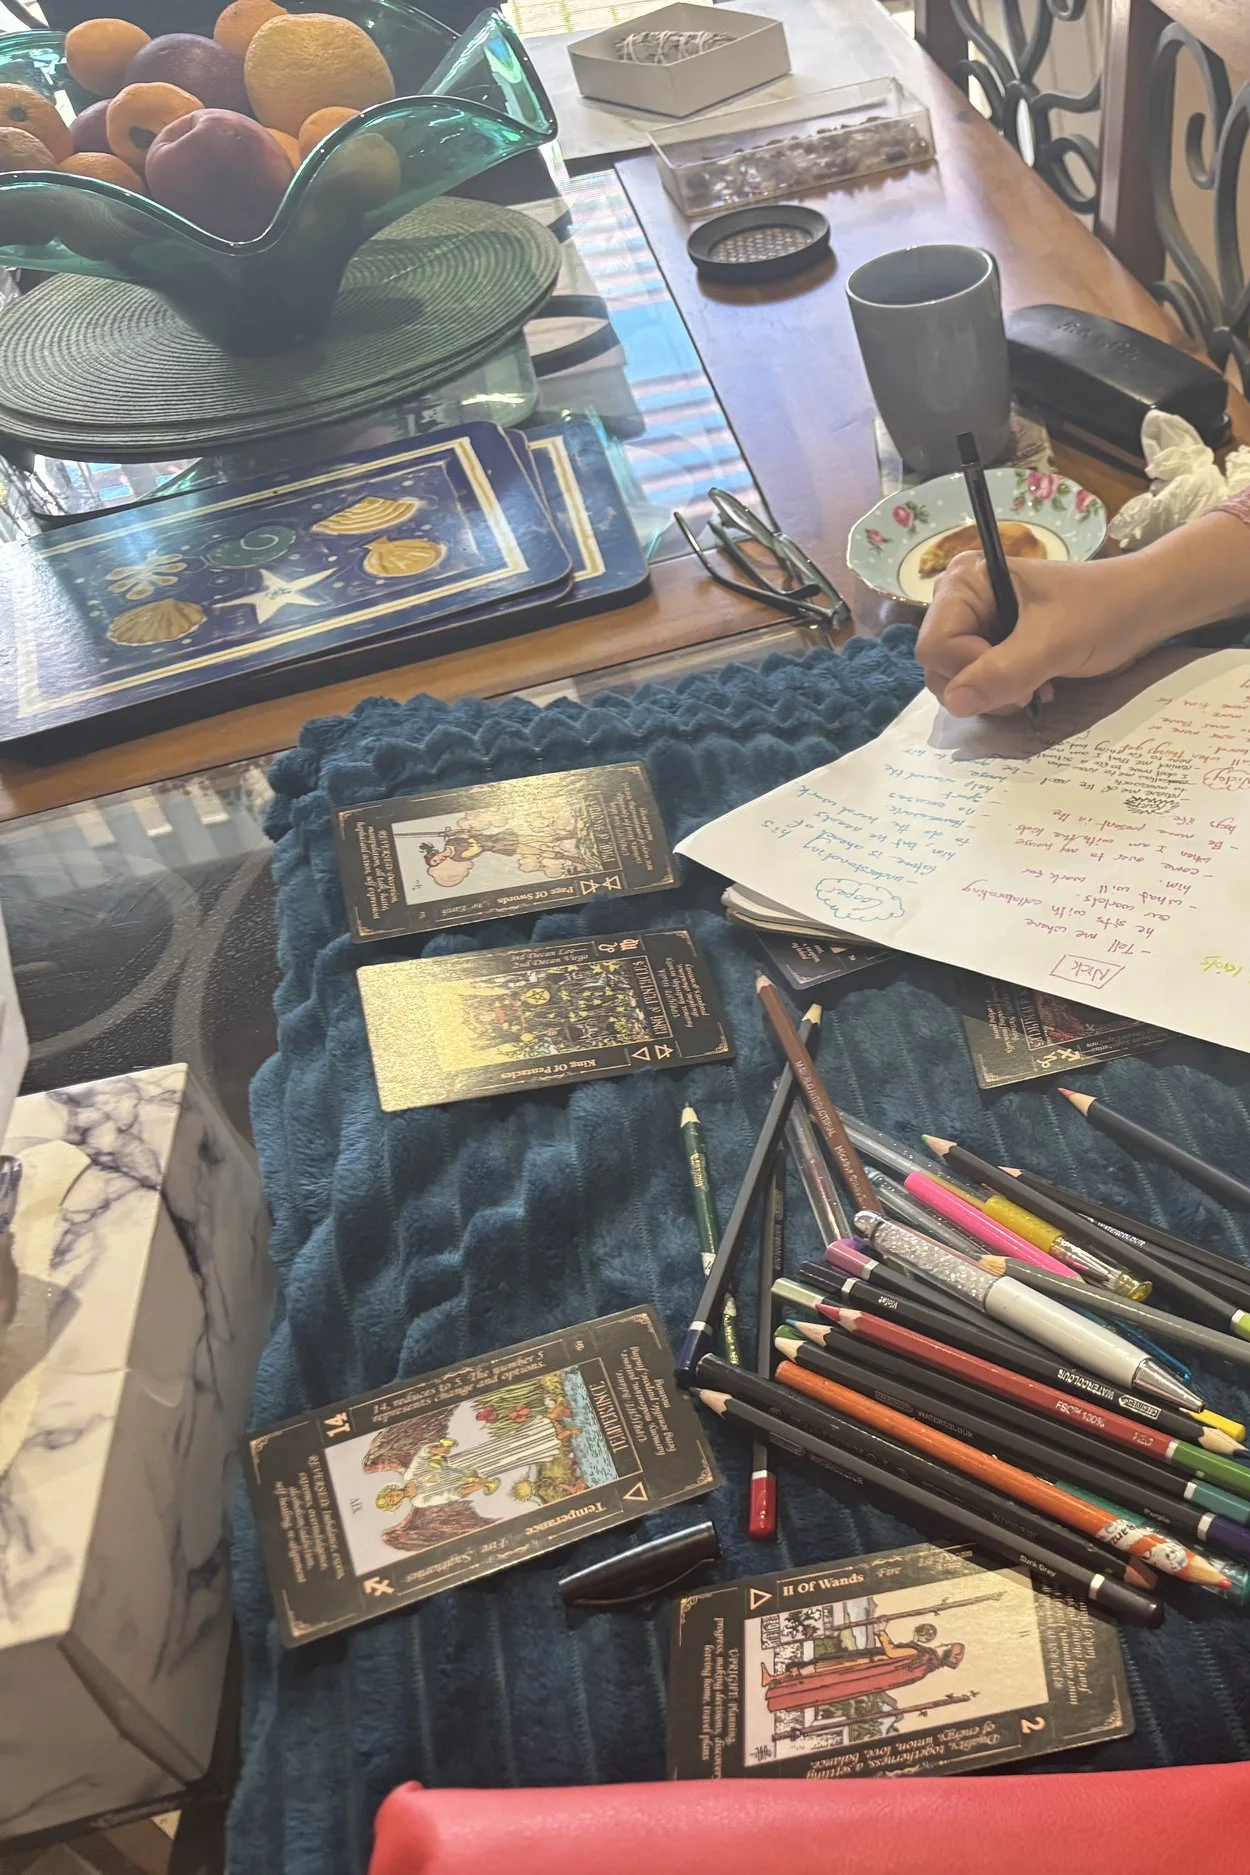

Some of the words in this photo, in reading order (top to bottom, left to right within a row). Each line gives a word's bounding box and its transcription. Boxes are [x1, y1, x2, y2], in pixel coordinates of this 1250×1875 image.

[1090, 852, 1104, 862] to
[535, 890, 549, 899] Of
[550, 886, 574, 895] Page
[497, 893, 534, 905] Swords
[1051, 904, 1087, 919] with
[1075, 930, 1099, 940] me
[1071, 960, 1111, 982] Nick
[553, 1063, 568, 1073] Of
[568, 1059, 597, 1068] King
[500, 1066, 553, 1079] Pentacles
[877, 1295, 898, 1310] Violet
[1057, 1368, 1115, 1401] WATERCOLOUR
[321, 1411, 351, 1438] 14
[1081, 1410, 1105, 1428] 100%
[525, 1501, 607, 1536] Temperance
[797, 1581, 816, 1594] Of
[818, 1573, 865, 1590] Wands
